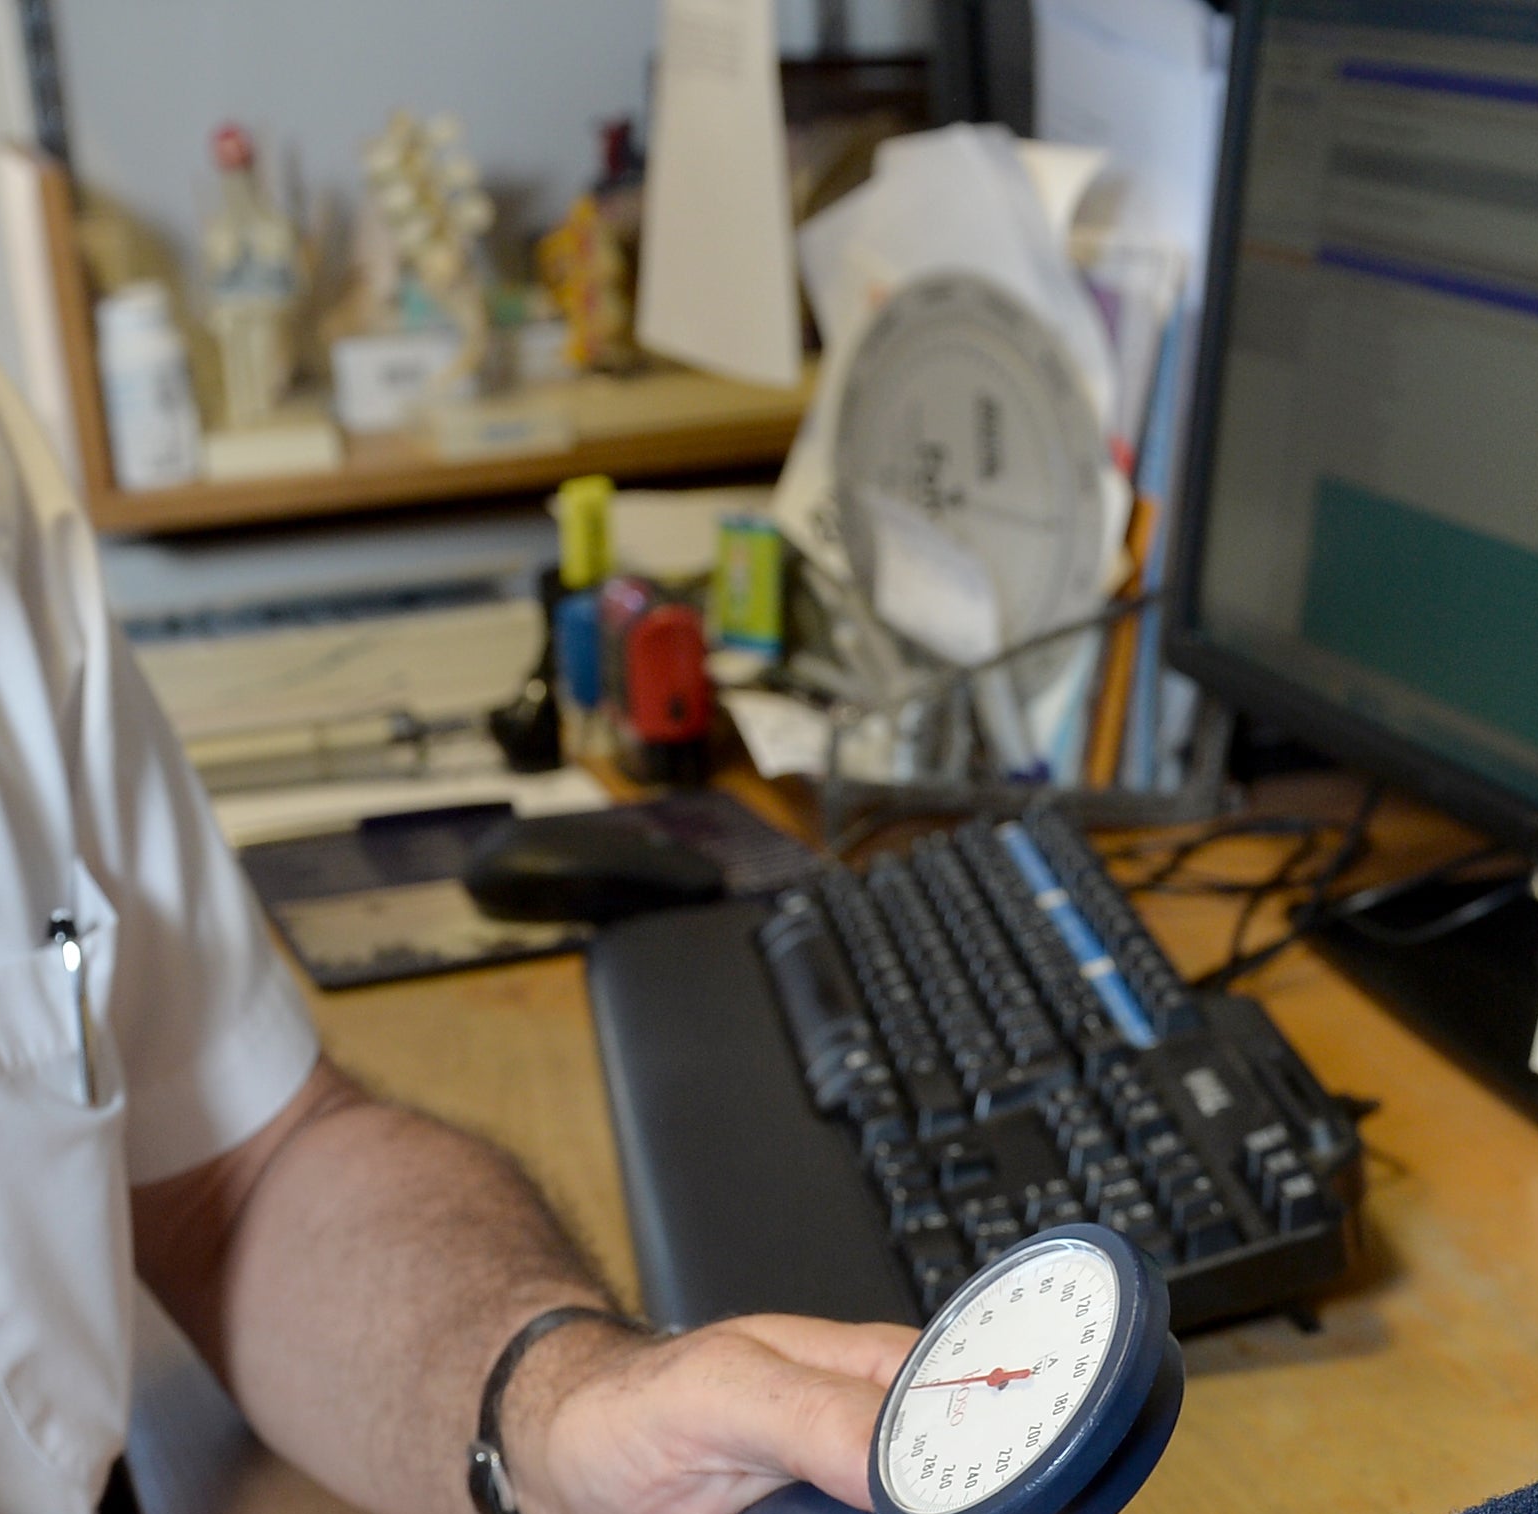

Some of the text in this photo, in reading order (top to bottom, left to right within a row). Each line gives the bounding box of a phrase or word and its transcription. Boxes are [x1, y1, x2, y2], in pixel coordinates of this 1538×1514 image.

[1010, 1287, 1025, 1303] 60
[1039, 1276, 1055, 1294] 80
[1060, 1279, 1077, 1302] 100
[979, 1310, 994, 1325] 40
[1075, 1294, 1092, 1318] 120
[1080, 1321, 1097, 1344] 140
[952, 1339, 966, 1355] 20
[1072, 1354, 1090, 1379] 160
[1052, 1392, 1069, 1416] 180
[910, 1433, 927, 1458] 300
[1025, 1422, 1043, 1448] 200
[920, 1454, 938, 1480] 280
[995, 1447, 1013, 1473] 220
[939, 1464, 956, 1490] 260
[964, 1463, 982, 1489] 240
